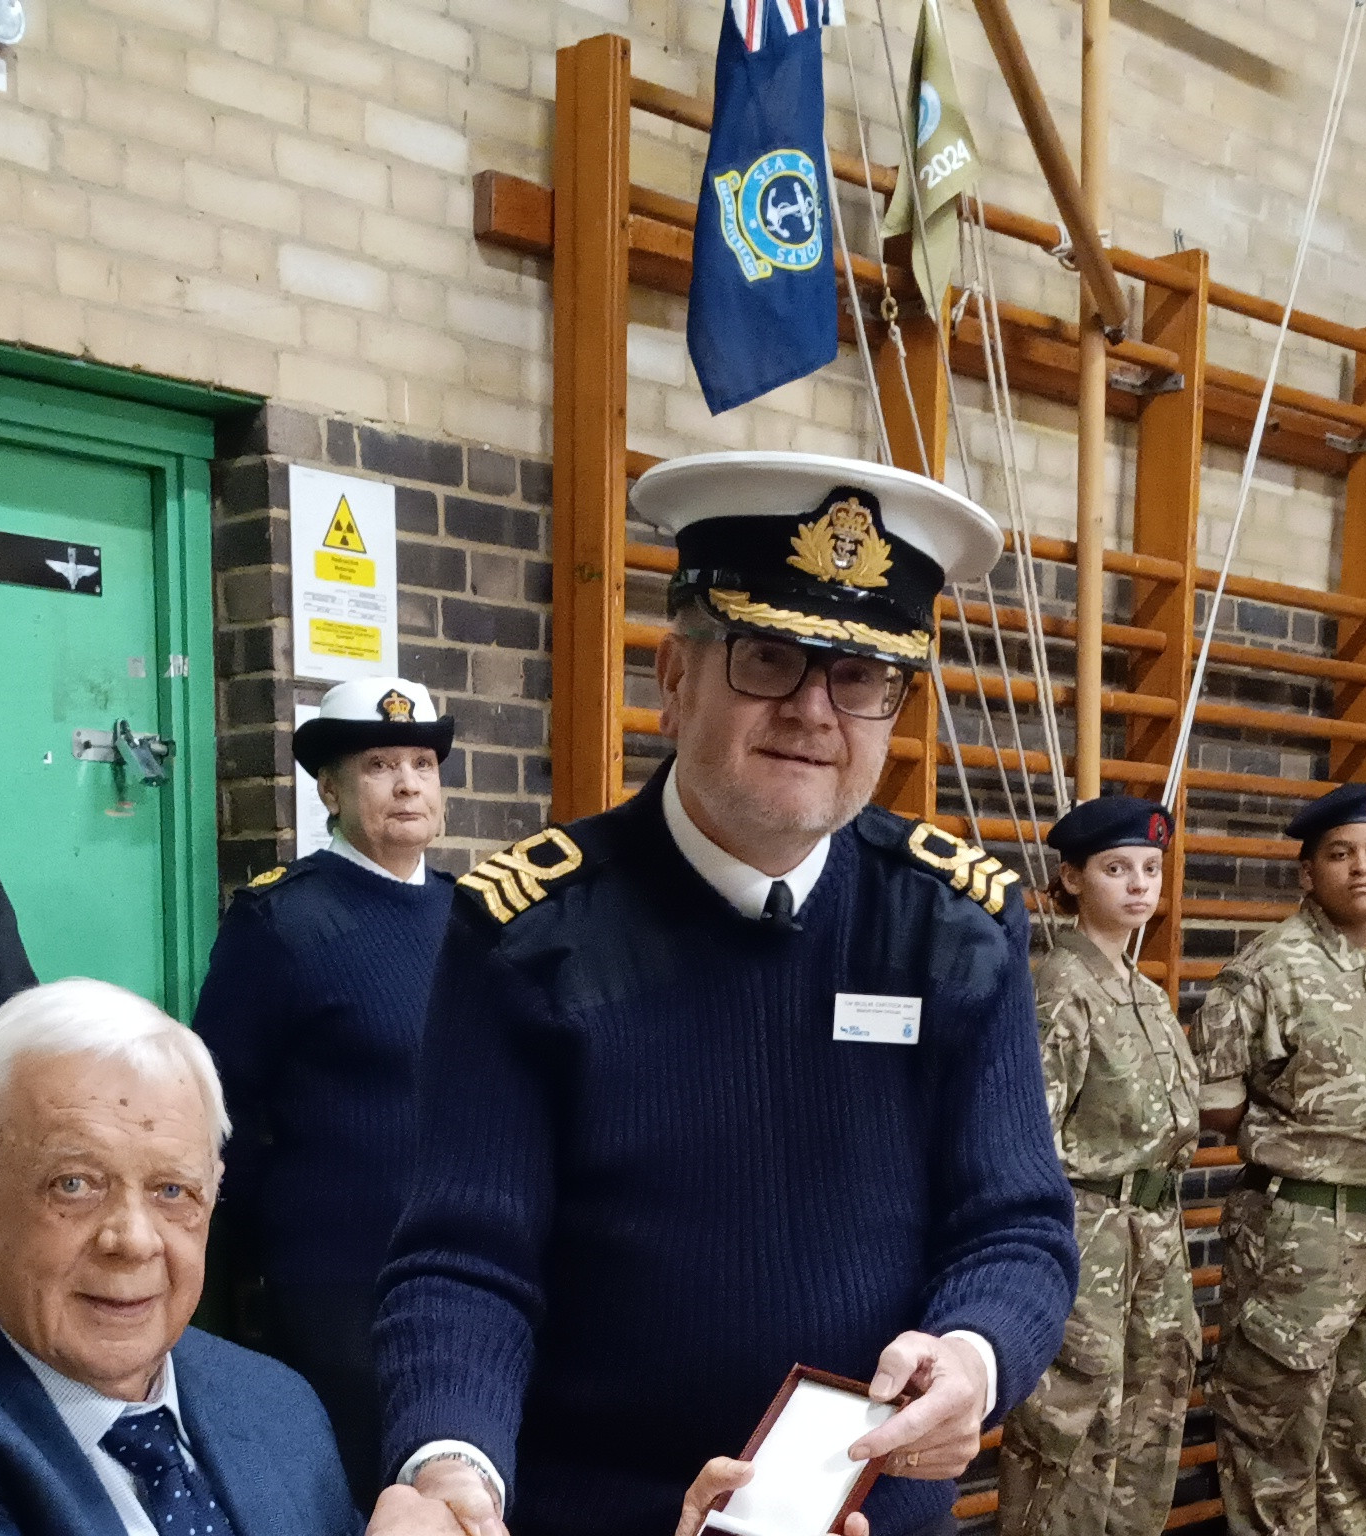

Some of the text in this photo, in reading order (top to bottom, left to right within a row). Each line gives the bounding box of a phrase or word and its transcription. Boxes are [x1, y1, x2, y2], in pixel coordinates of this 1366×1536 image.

[753, 156, 787, 185] SEA
[920, 138, 971, 190] 2024
[777, 236, 822, 264] ORPS
